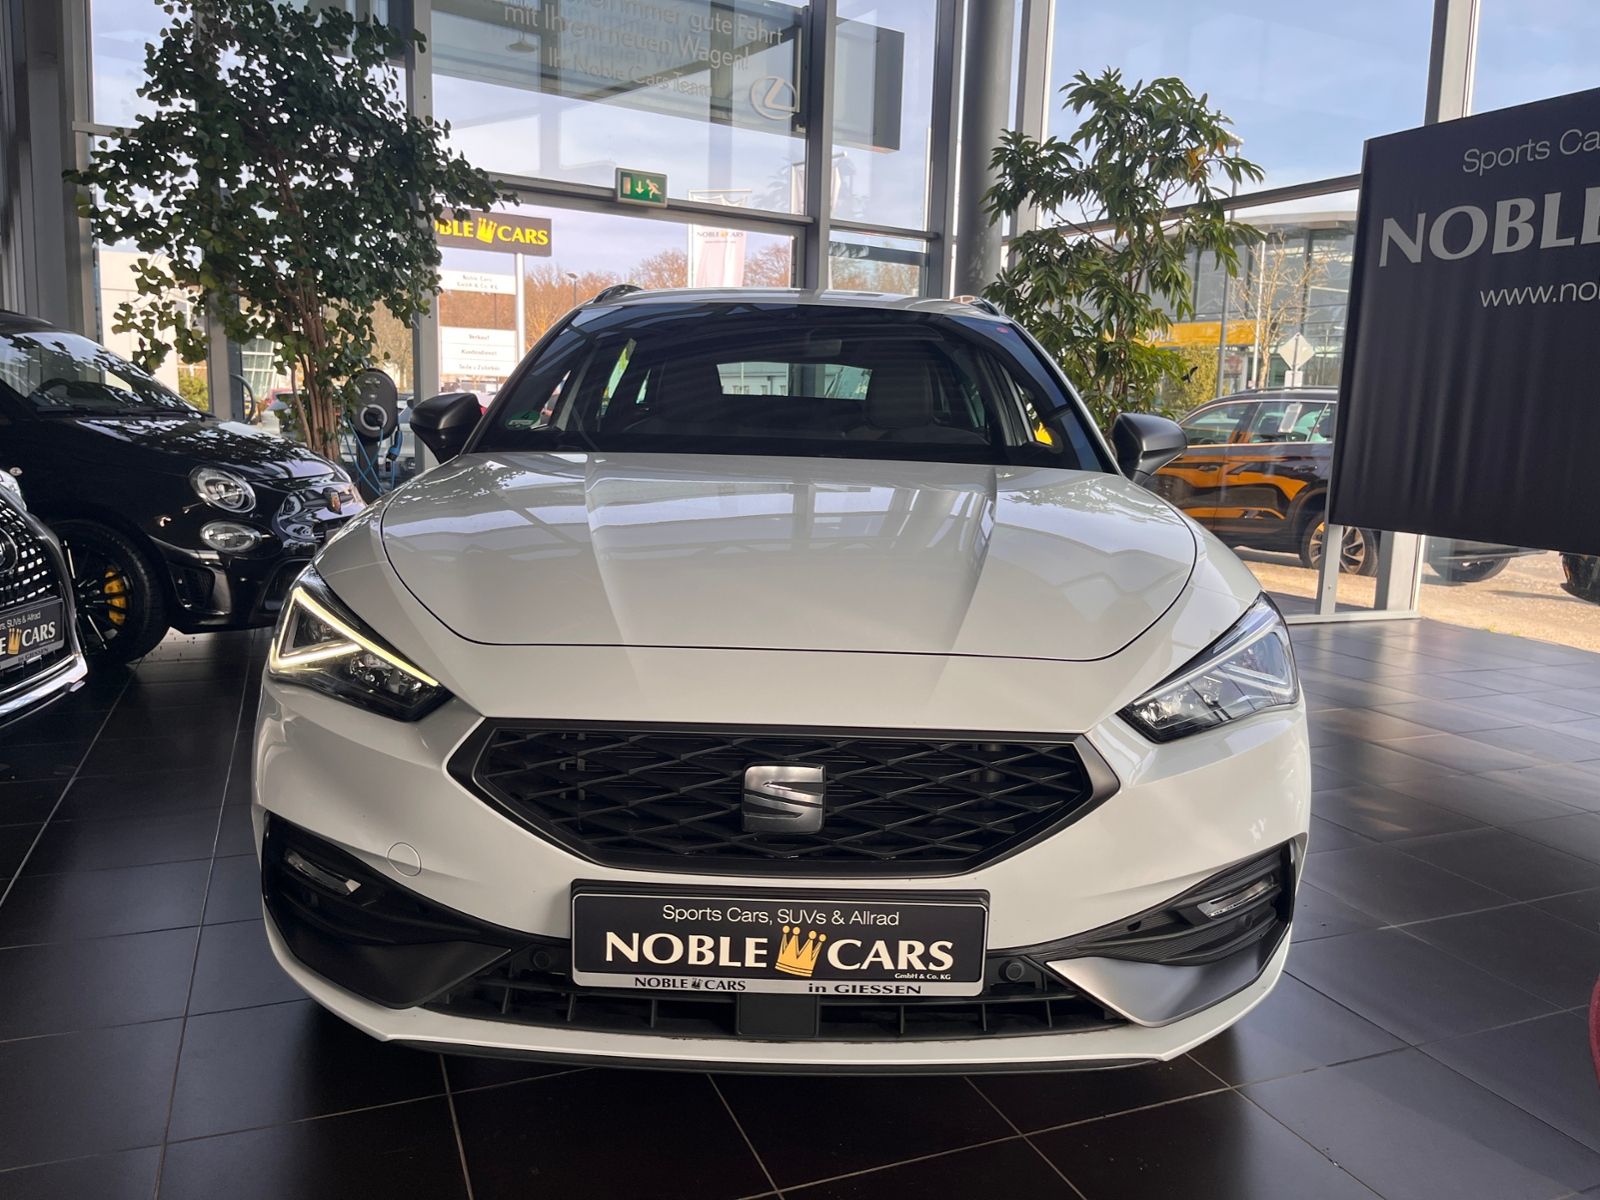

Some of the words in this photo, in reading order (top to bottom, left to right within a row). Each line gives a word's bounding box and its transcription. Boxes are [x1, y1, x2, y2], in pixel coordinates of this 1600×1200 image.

[504, 5, 538, 27] mit
[608, 28, 673, 54] neuen
[679, 33, 749, 69] Wagen!
[690, 13, 732, 34] gute
[736, 14, 784, 45] Fahrt
[575, 54, 624, 81] Noble
[628, 65, 670, 90] Cars
[673, 71, 713, 98] Team
[1462, 138, 1550, 176] Sports
[497, 225, 549, 246] CARS
[1479, 281, 1600, 308] www.no
[22, 621, 56, 647] CARS
[662, 904, 722, 923] Sports
[727, 907, 773, 925] Cars,
[777, 909, 826, 925] SUVs
[831, 910, 845, 925] &
[849, 910, 900, 926] Allrad
[606, 931, 768, 968] NOBLE
[827, 939, 954, 971] CARS
[634, 977, 688, 988] NOBLE
[704, 980, 746, 991] CARS
[808, 983, 826, 993] in
[834, 984, 922, 994] GIESSEN
